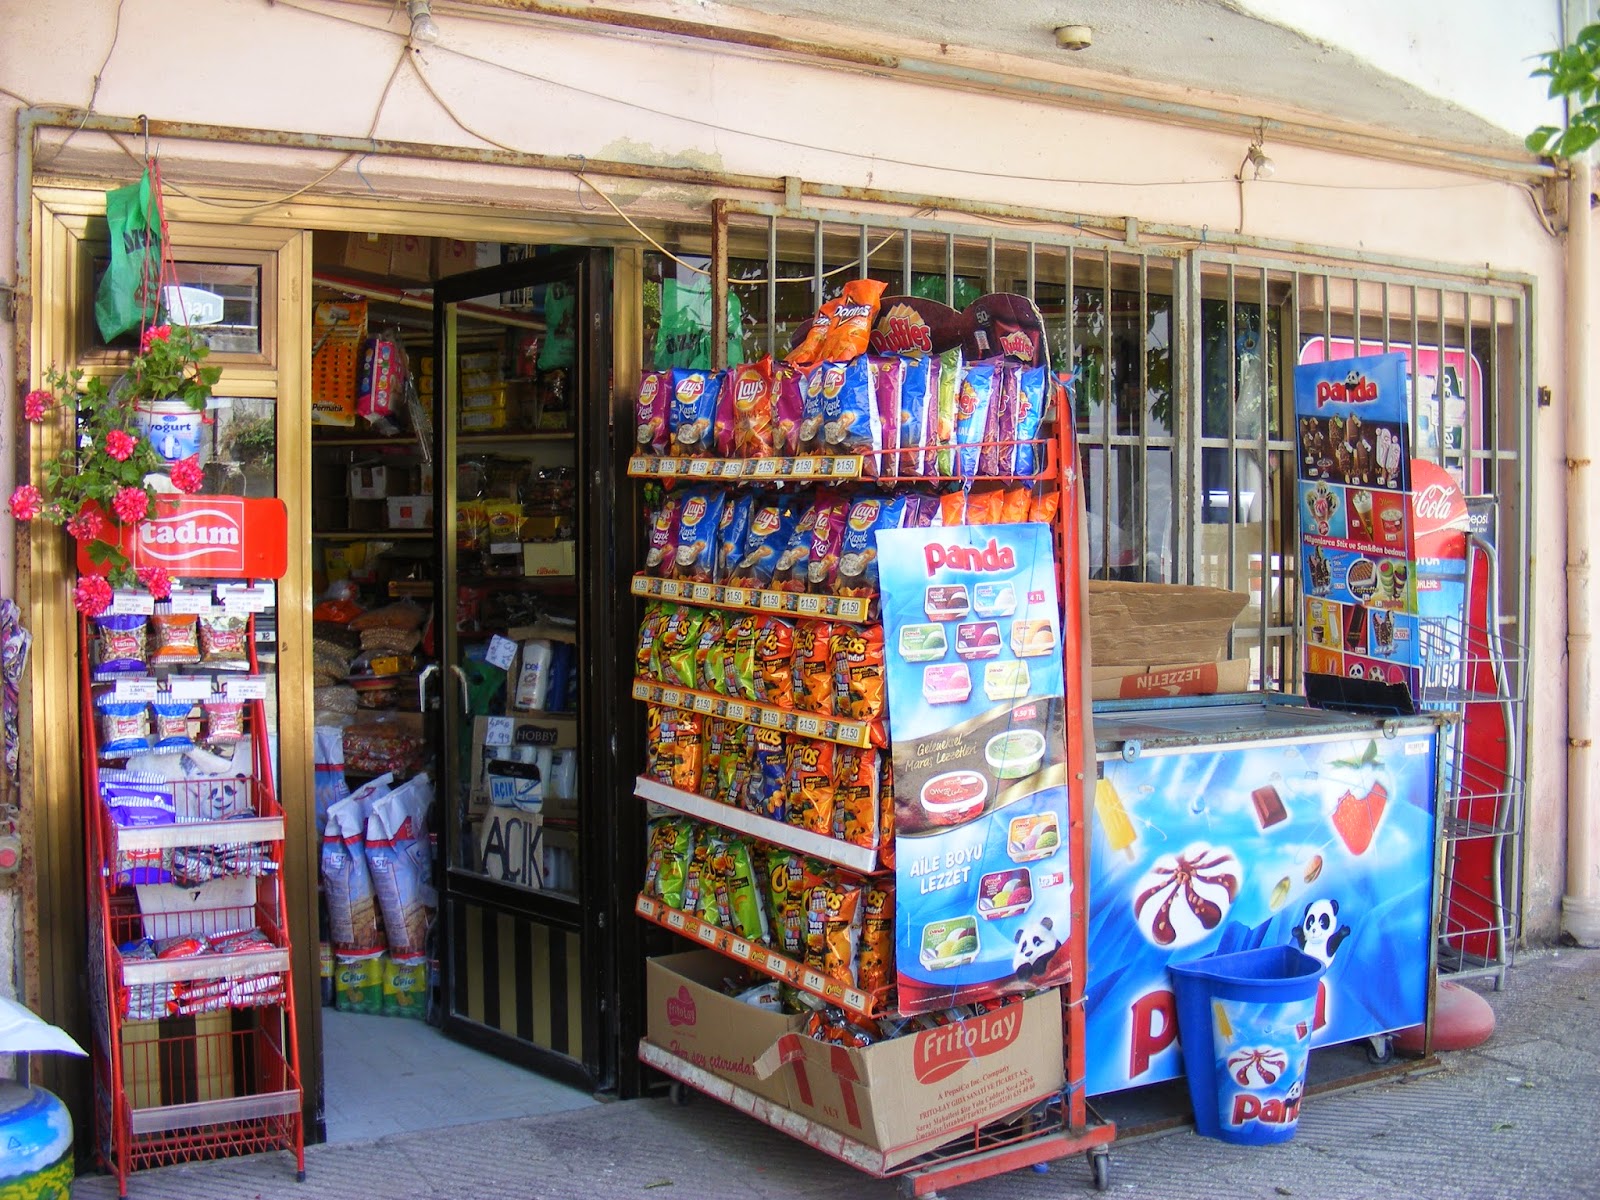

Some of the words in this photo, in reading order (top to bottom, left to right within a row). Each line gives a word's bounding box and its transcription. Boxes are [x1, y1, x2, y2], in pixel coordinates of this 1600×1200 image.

[834, 304, 871, 319] Doritos
[871, 316, 932, 352] Ruffles
[1000, 336, 1034, 357] Ruffles
[738, 380, 763, 402] Lay's
[1317, 376, 1377, 408] panda
[851, 505, 878, 522] Lay's
[139, 521, 239, 545] tadım
[924, 538, 1015, 577] panda
[1336, 540, 1348, 548] Stix
[1384, 547, 1406, 557] bedava
[1137, 668, 1200, 690] LEZZETİN
[516, 730, 556, 743] HOBBY
[917, 733, 963, 757] Geleneksel
[494, 781, 514, 800] AÇIK
[481, 816, 544, 890] AÇIK
[910, 856, 940, 878] AİLE
[945, 843, 983, 869] BOYU
[920, 866, 971, 895] LEZZET
[944, 1084, 969, 1098] PepsiCo
[982, 1064, 1010, 1081] Company
